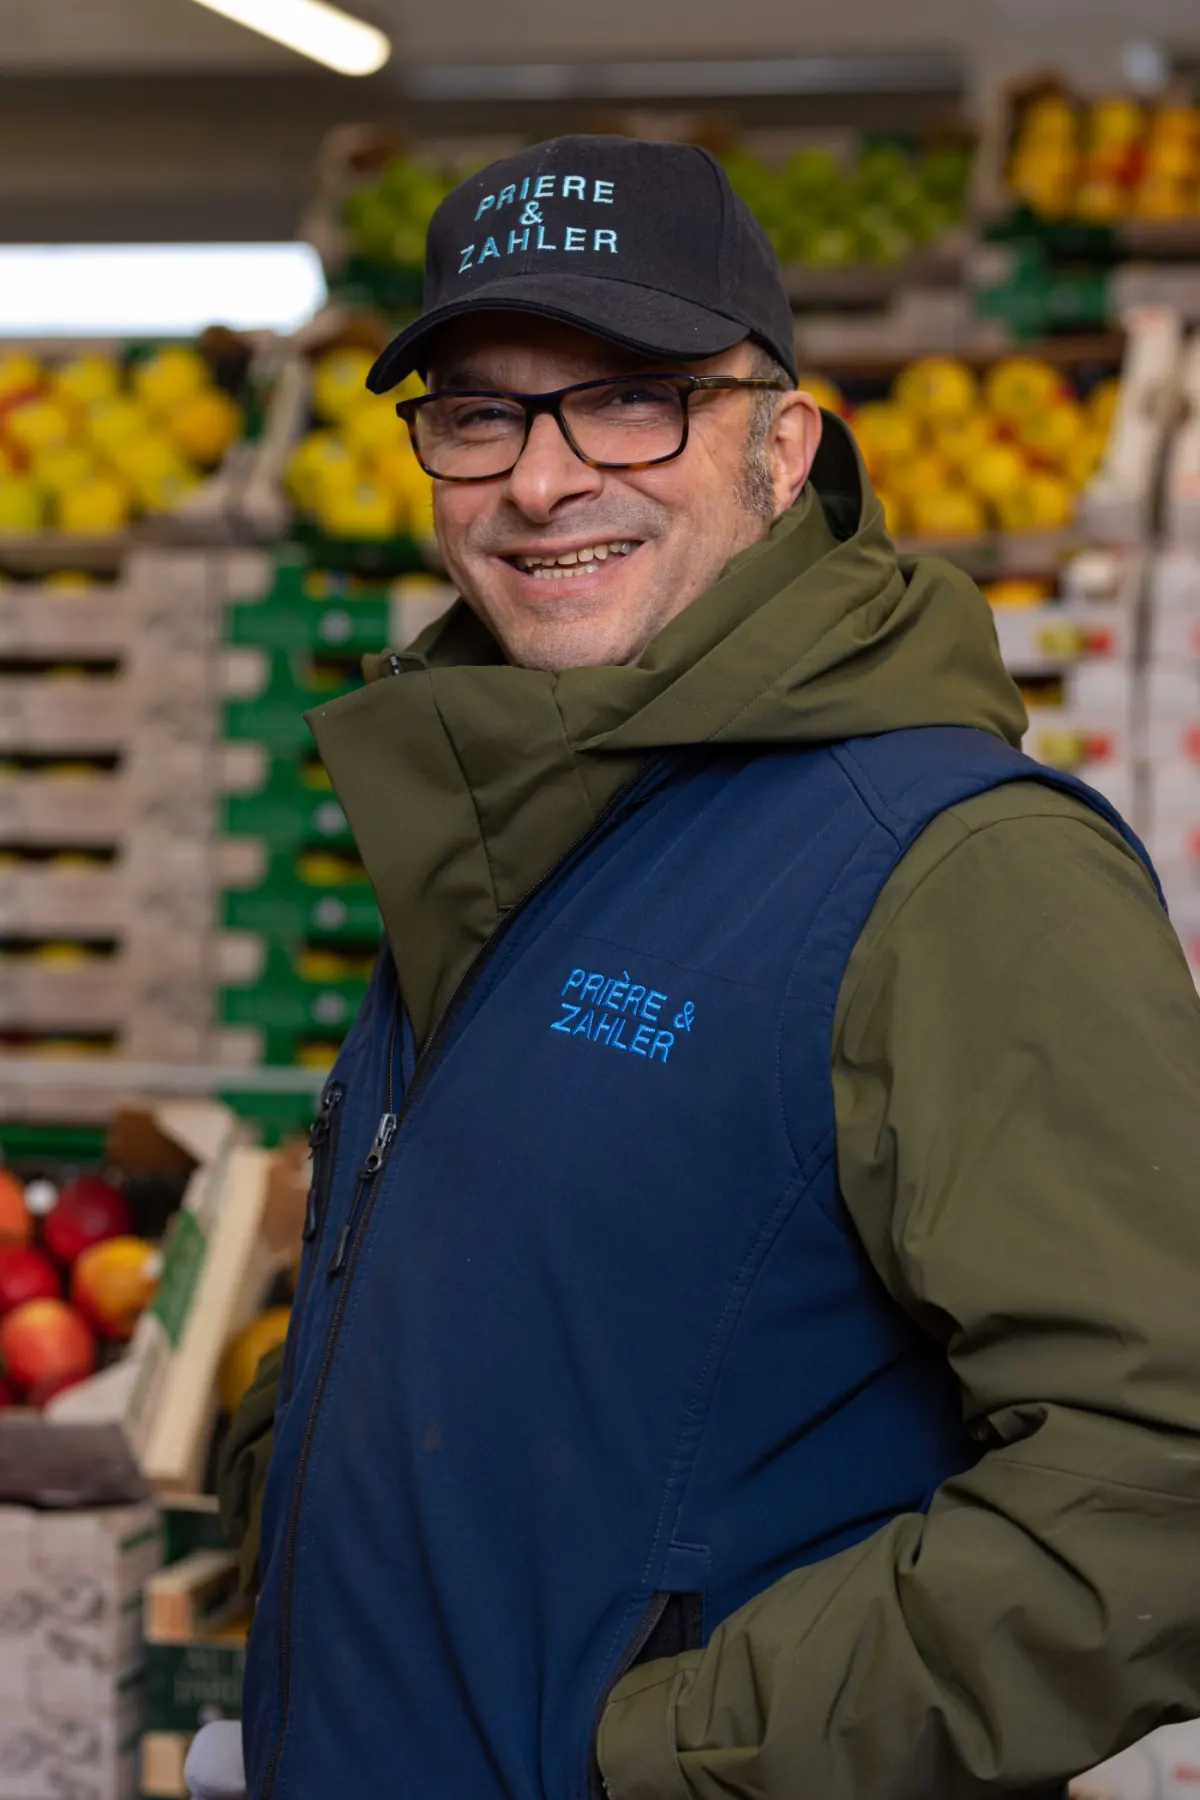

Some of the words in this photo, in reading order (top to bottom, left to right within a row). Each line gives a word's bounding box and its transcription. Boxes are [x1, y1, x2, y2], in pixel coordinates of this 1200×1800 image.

[474, 175, 615, 221] PRIERE
[518, 200, 544, 225] &
[458, 225, 618, 274] ZAHLER
[561, 968, 668, 1022] PRIÈRE
[672, 1000, 695, 1032] &
[550, 1002, 675, 1064] ZAHLER
